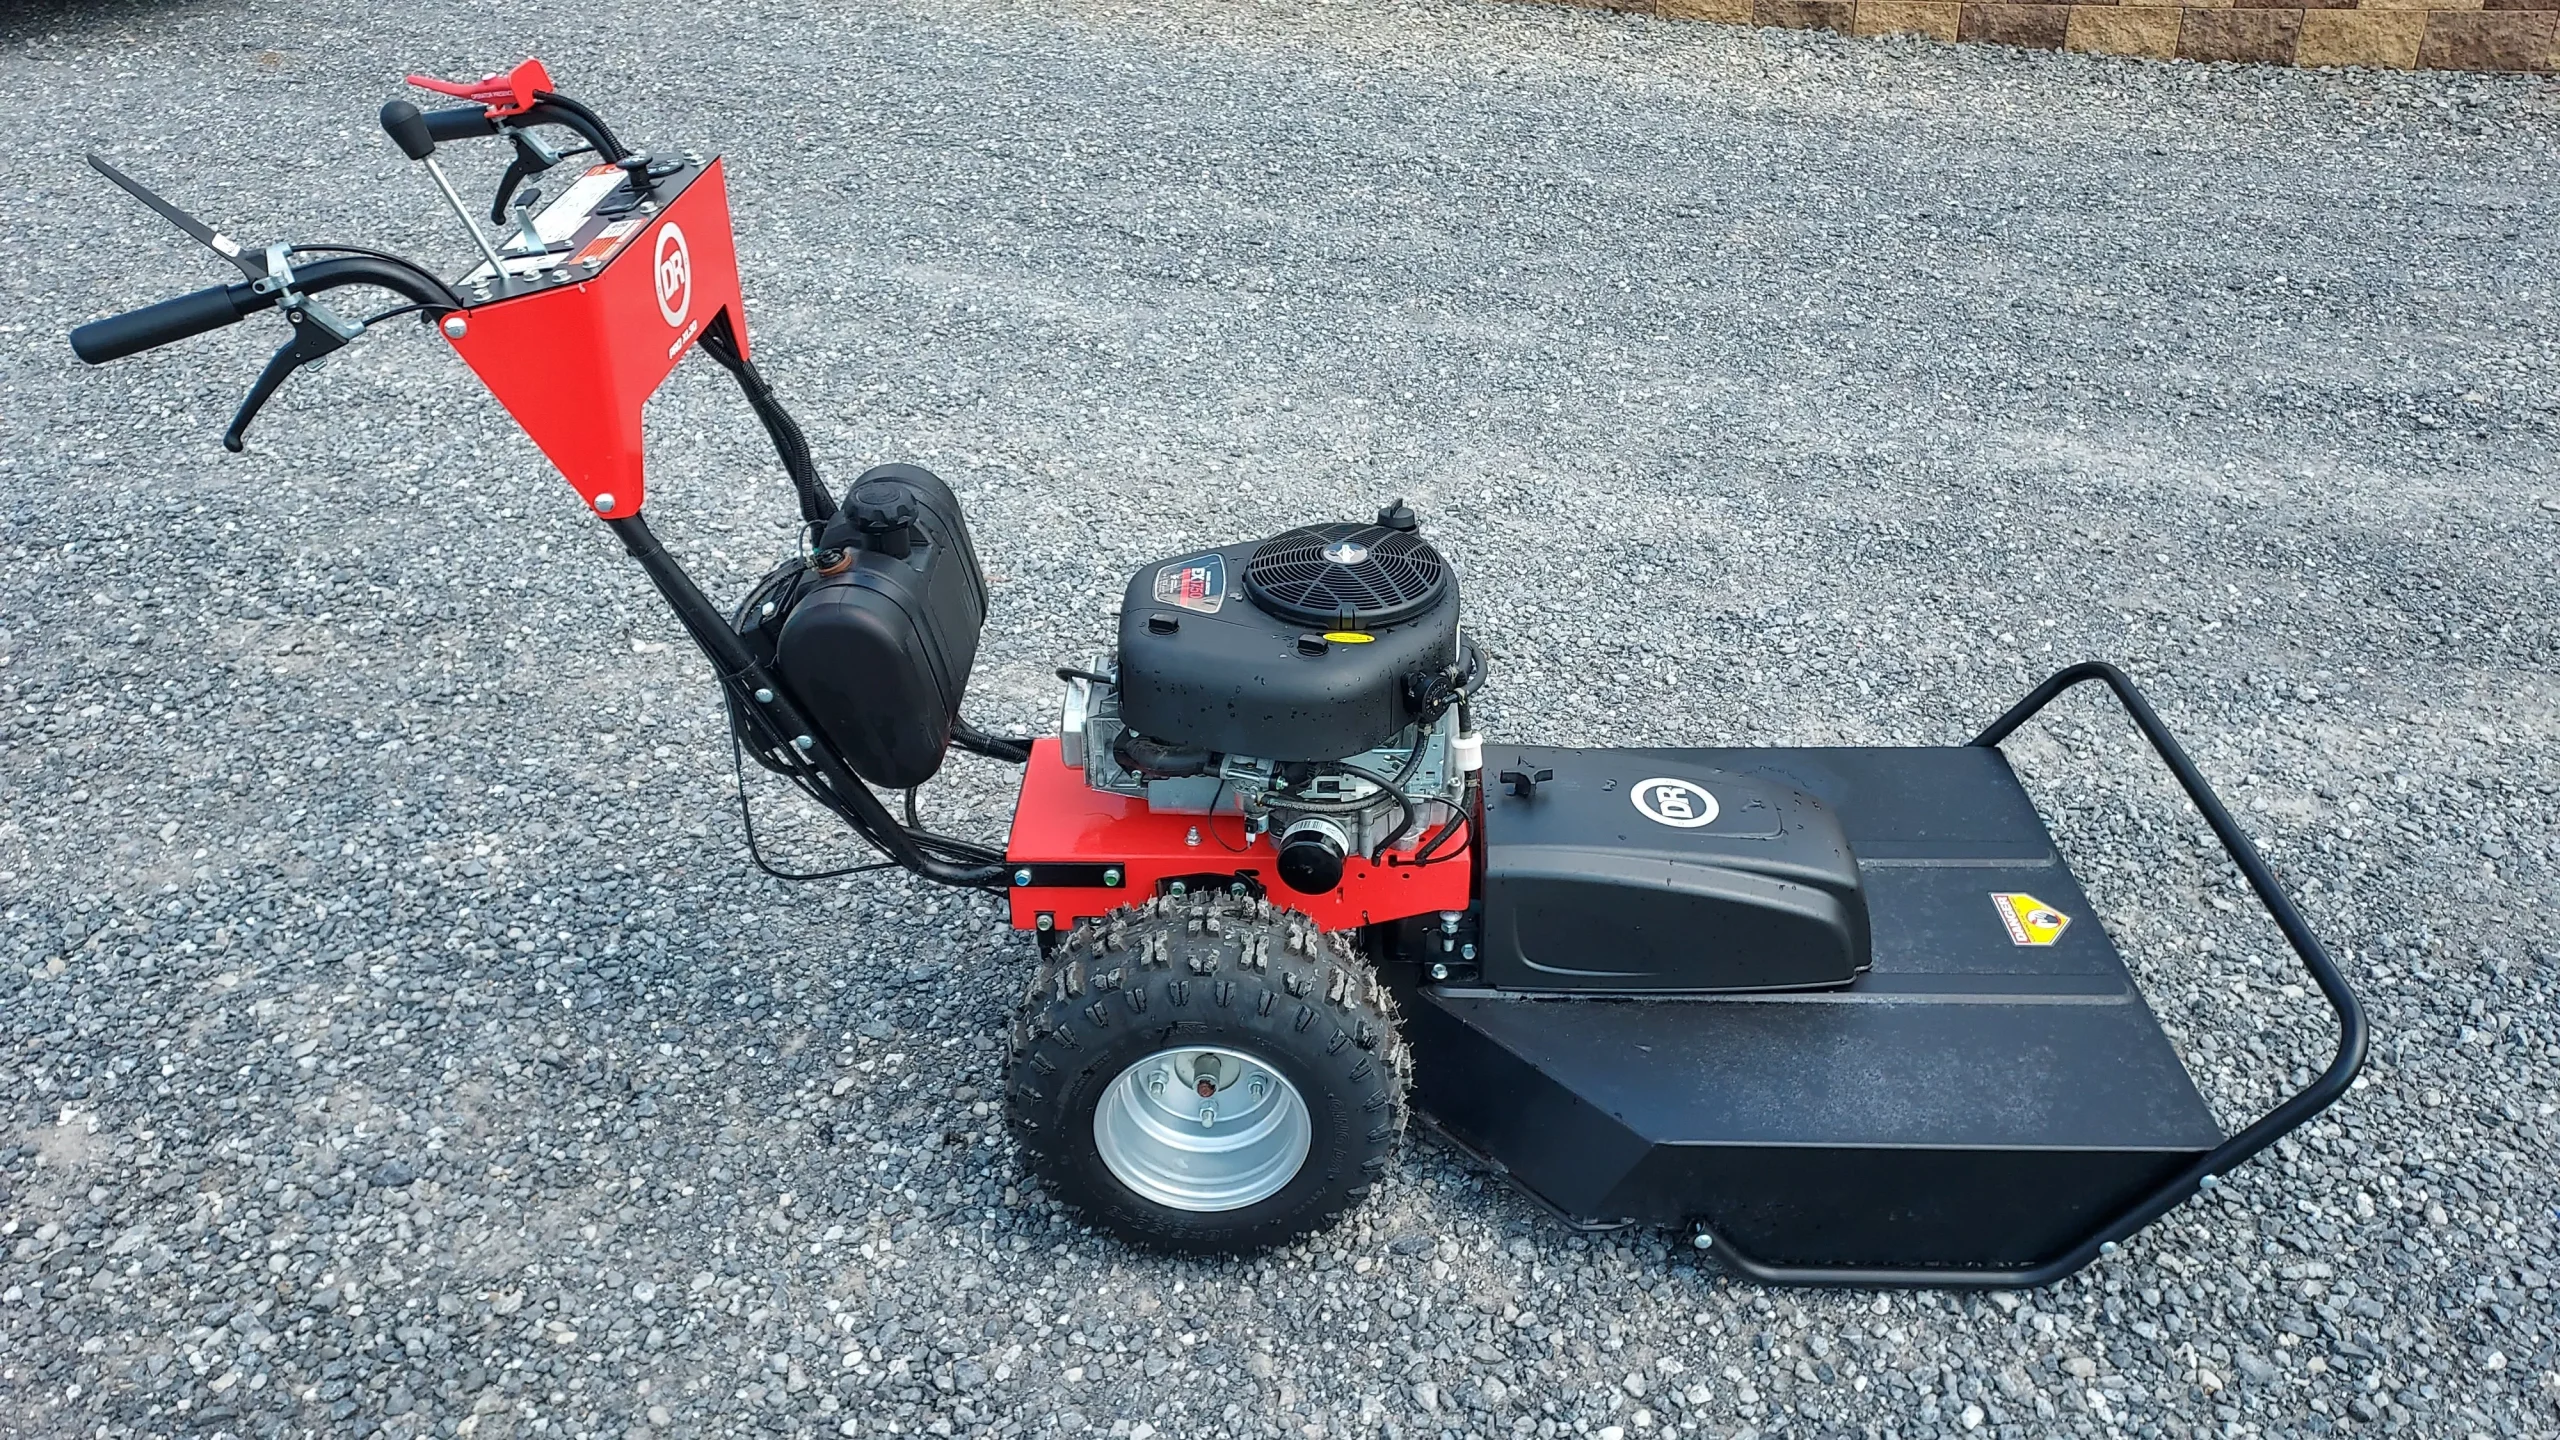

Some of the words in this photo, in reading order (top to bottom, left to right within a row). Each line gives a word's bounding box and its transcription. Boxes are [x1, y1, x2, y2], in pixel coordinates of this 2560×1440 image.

[660, 249, 685, 300] DR
[668, 337, 682, 360] PRO
[1656, 786, 1694, 818] DR
[1997, 896, 2028, 941] DANGER
